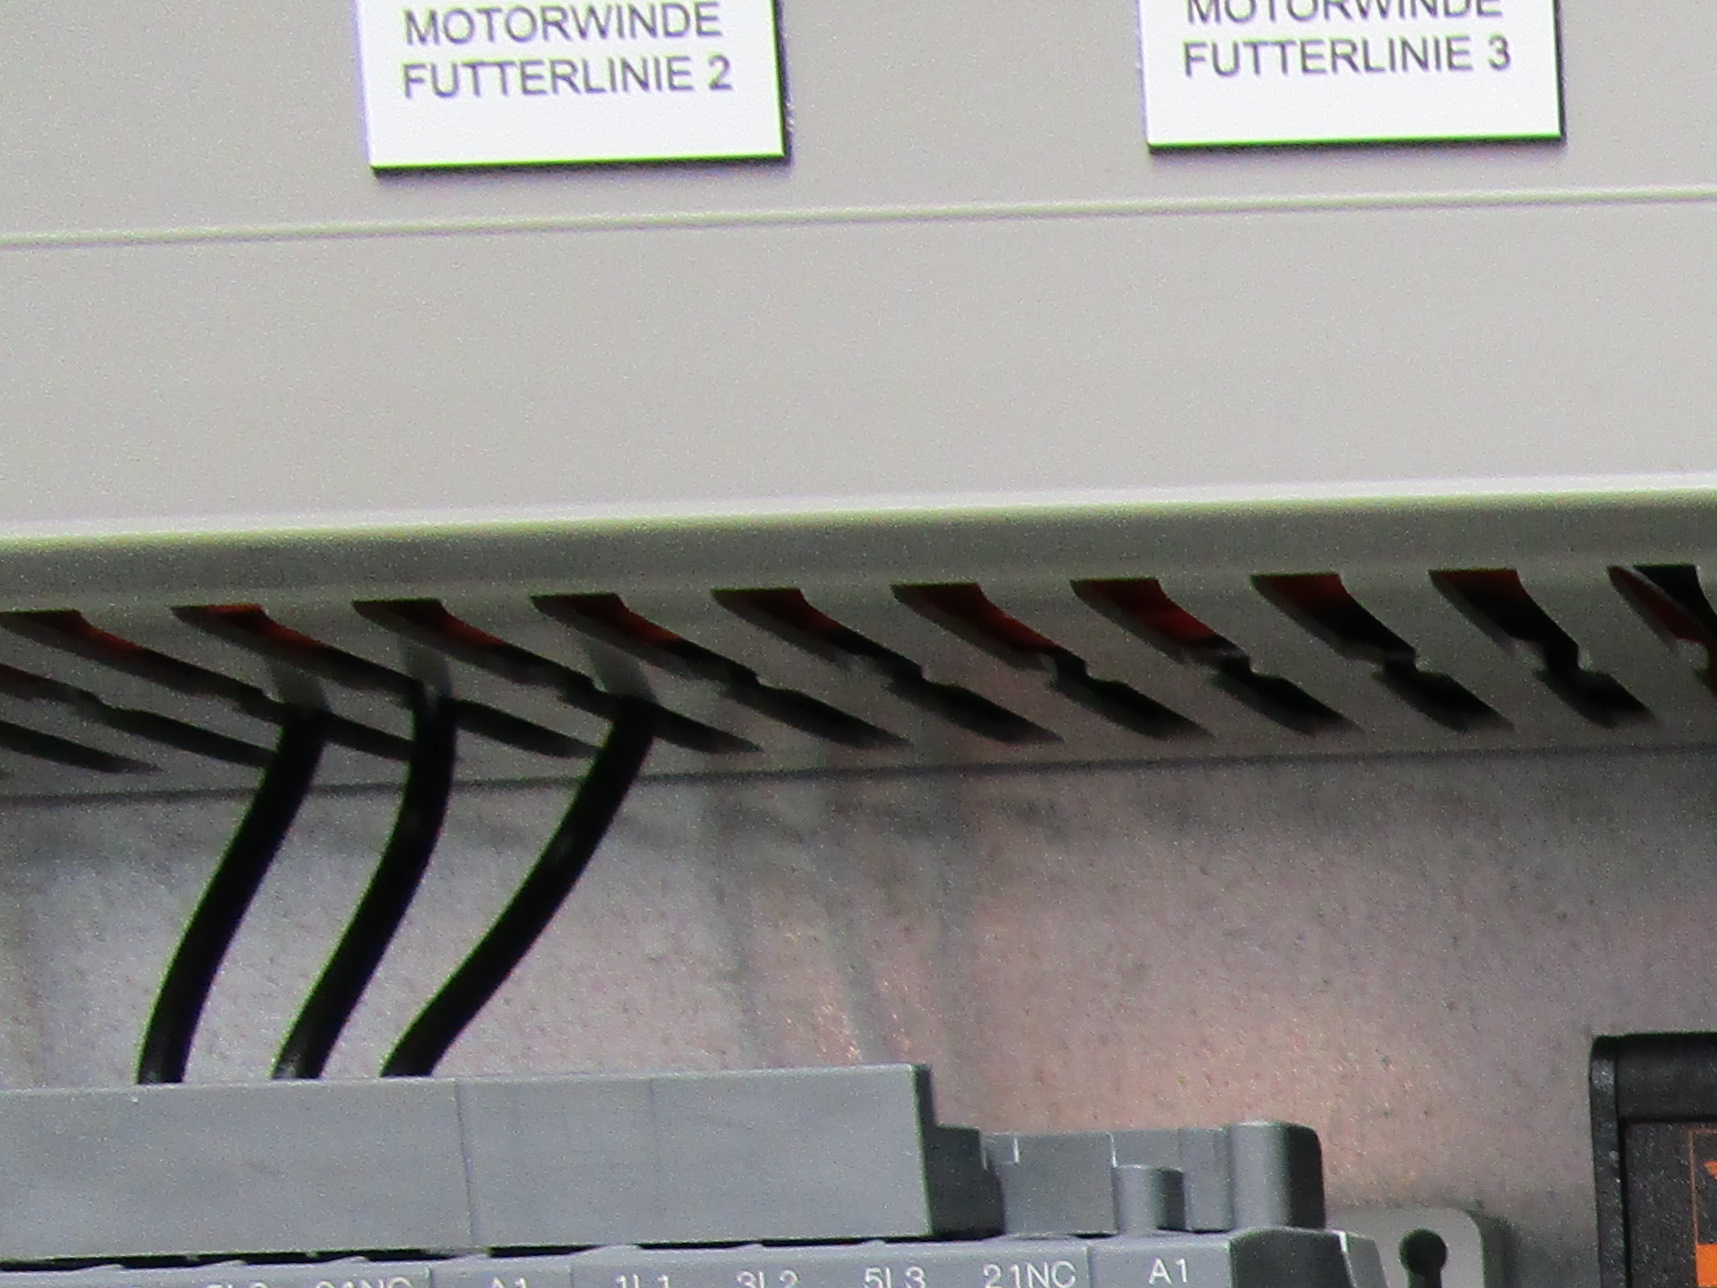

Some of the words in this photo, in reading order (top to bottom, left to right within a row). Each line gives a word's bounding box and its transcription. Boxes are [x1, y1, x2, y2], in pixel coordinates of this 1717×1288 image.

[404, 1, 723, 46] MOTORWINDE
[402, 55, 695, 99] FUTTERLINIE
[708, 54, 733, 91] 2
[1183, 35, 1474, 77] FUTTERLINIE
[1487, 35, 1512, 71] 3
[1148, 1258, 1190, 1286] A1
